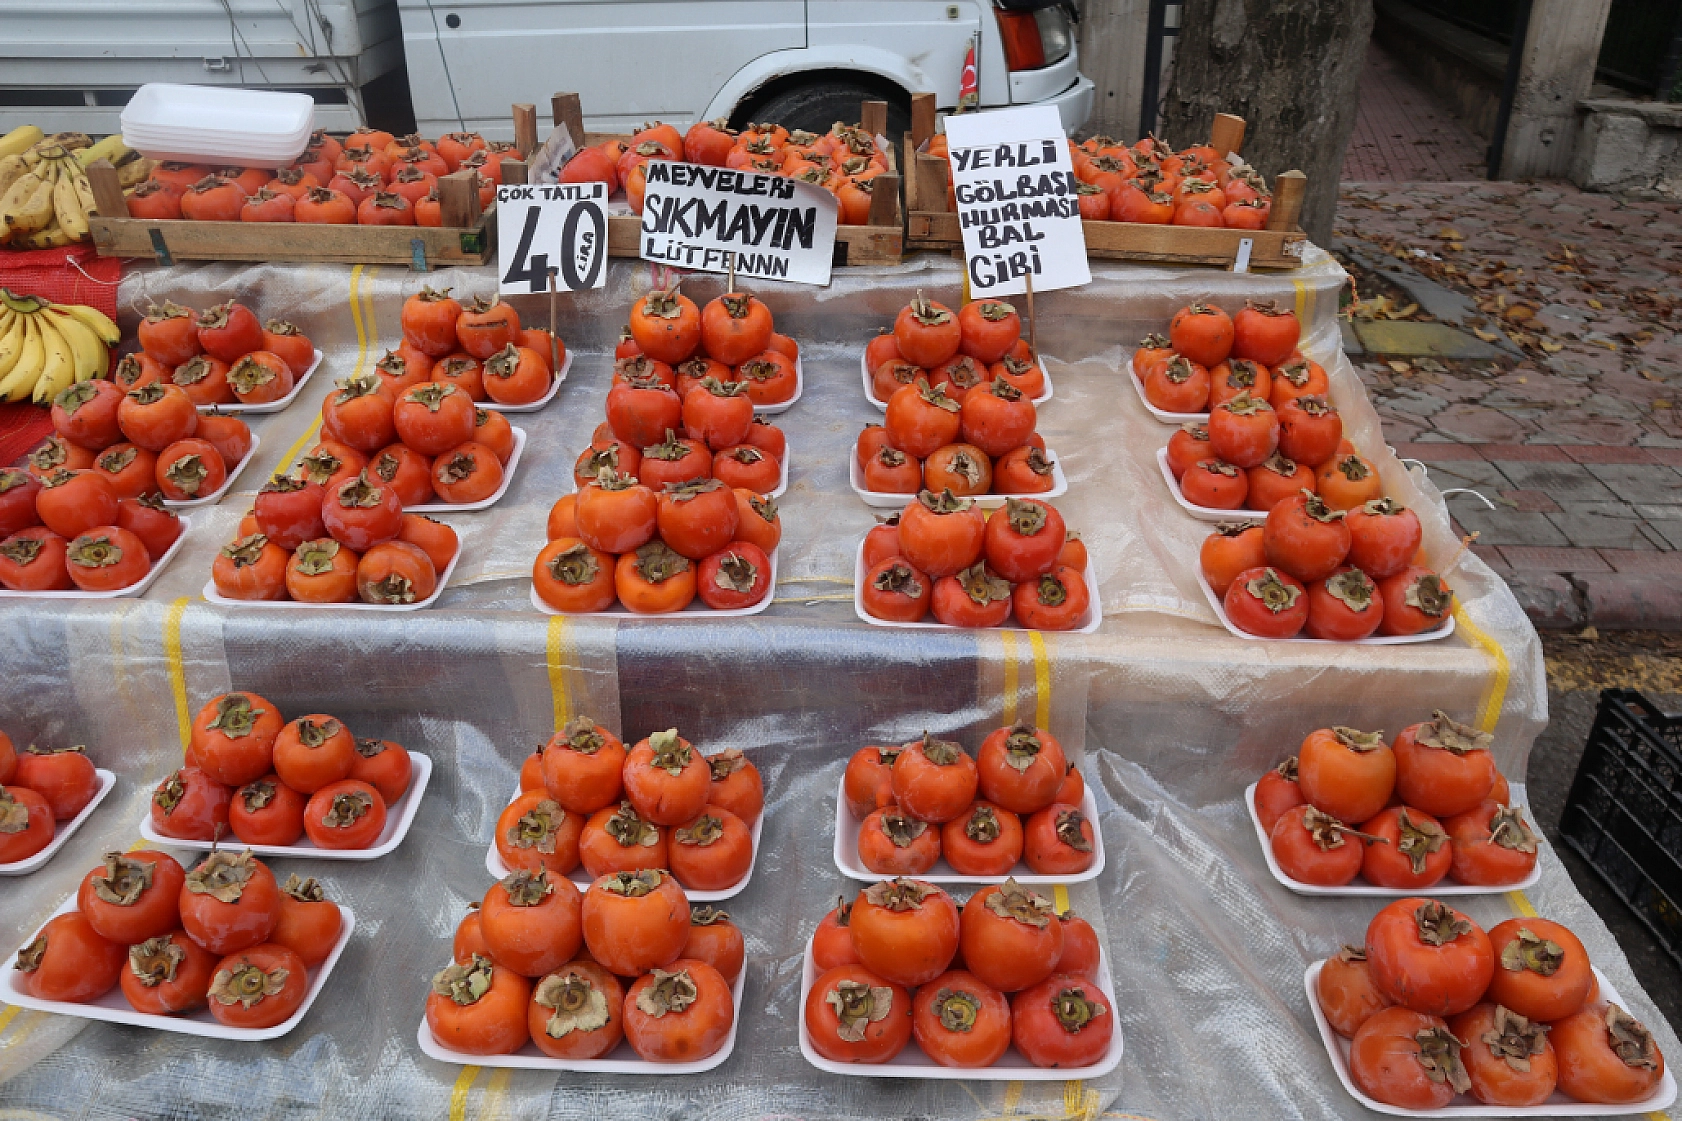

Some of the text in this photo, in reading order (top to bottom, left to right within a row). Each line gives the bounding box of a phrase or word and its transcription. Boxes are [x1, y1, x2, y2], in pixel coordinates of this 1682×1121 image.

[951, 140, 1057, 172] YERLİ
[498, 184, 602, 203] ÇOK TATLI
[642, 194, 816, 250] SIKMAYIN
[961, 198, 1081, 229] HURMASI
[502, 201, 605, 292] 40
[979, 222, 1045, 249] BAL
[970, 245, 1042, 288] GİBİ
